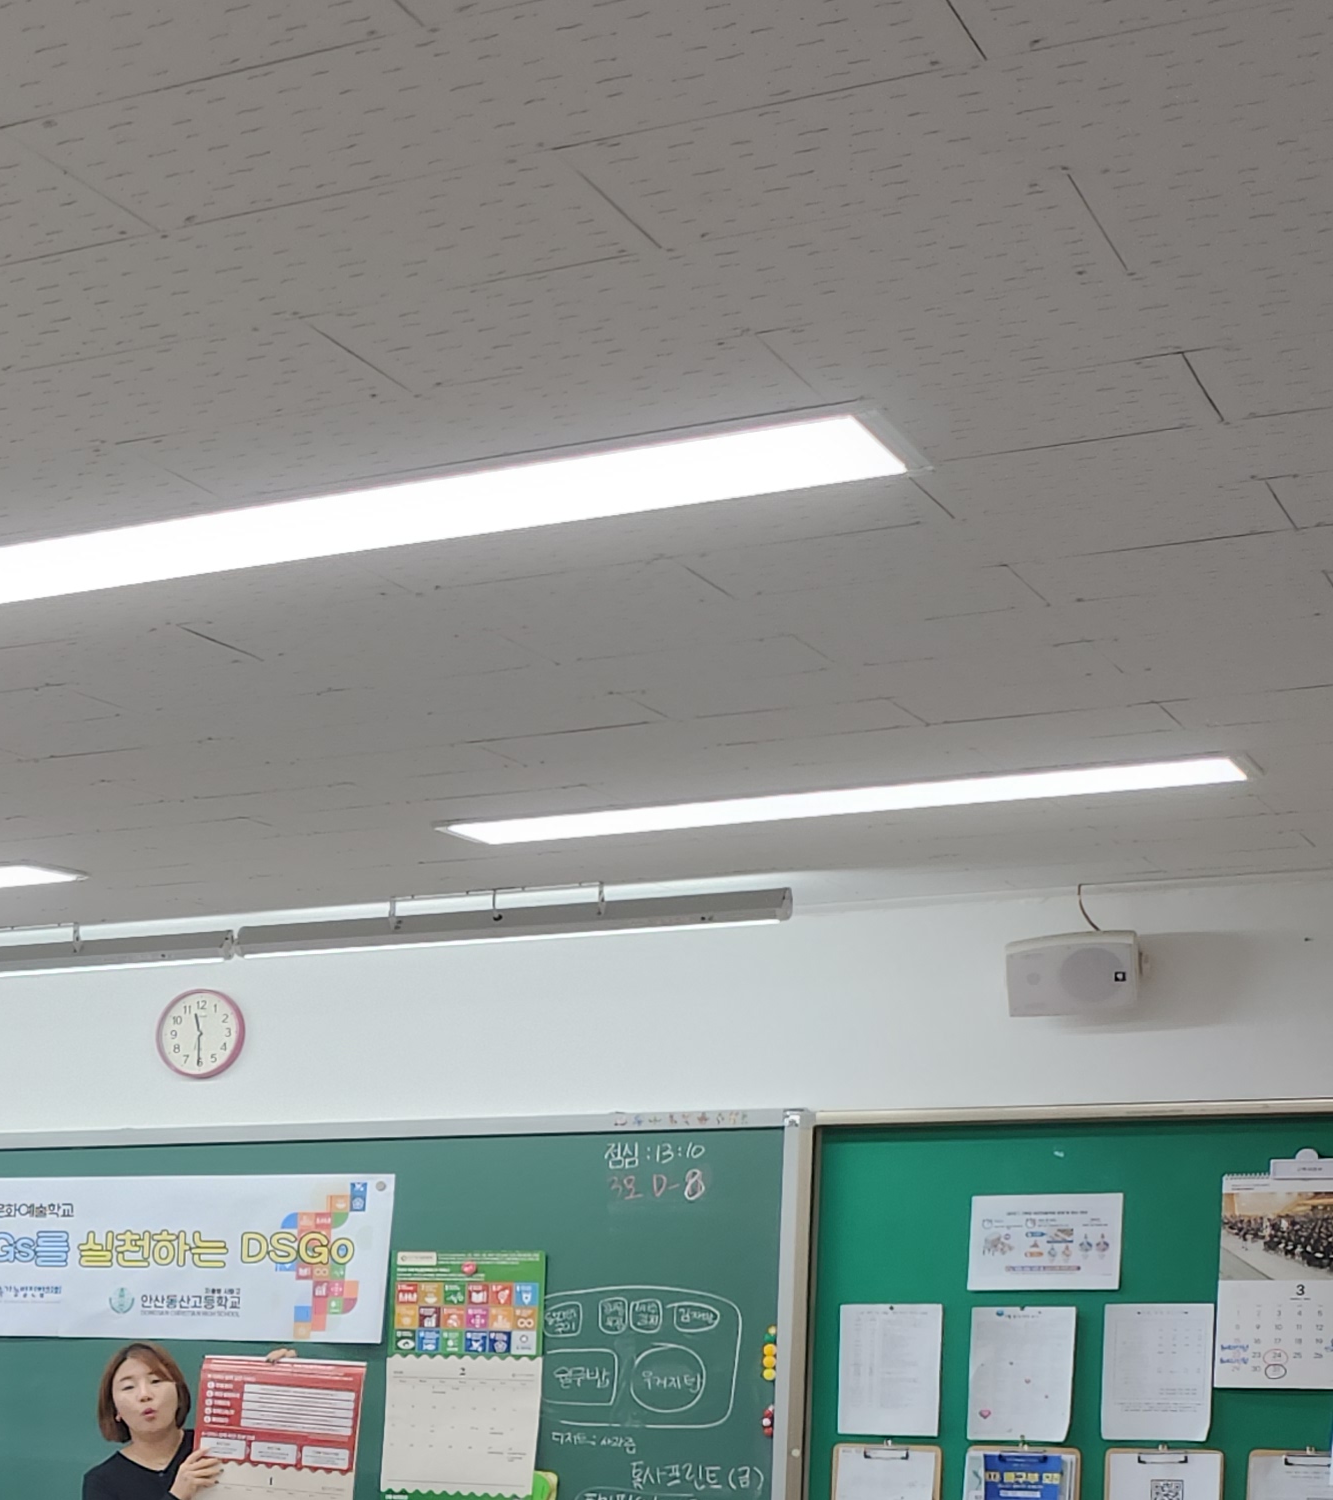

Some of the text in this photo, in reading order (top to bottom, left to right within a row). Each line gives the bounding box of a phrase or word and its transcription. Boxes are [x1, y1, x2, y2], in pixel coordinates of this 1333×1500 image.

[183, 1005, 192, 1015] 11
[196, 1000, 207, 1010] 12
[213, 1003, 218, 1013] 1
[172, 1015, 182, 1025] 10
[221, 1013, 229, 1023] 2
[170, 1029, 178, 1040] 9
[224, 1027, 232, 1037] 3
[172, 1043, 180, 1053] 8
[219, 1042, 227, 1051] 4
[182, 1054, 190, 1064] 7
[210, 1053, 217, 1063] 5
[77, 1229, 229, 1269] 실천하는
[240, 1231, 356, 1266] DSGo
[1295, 1284, 1306, 1296] 3
[140, 1294, 241, 1310] 안산동산고등학교
